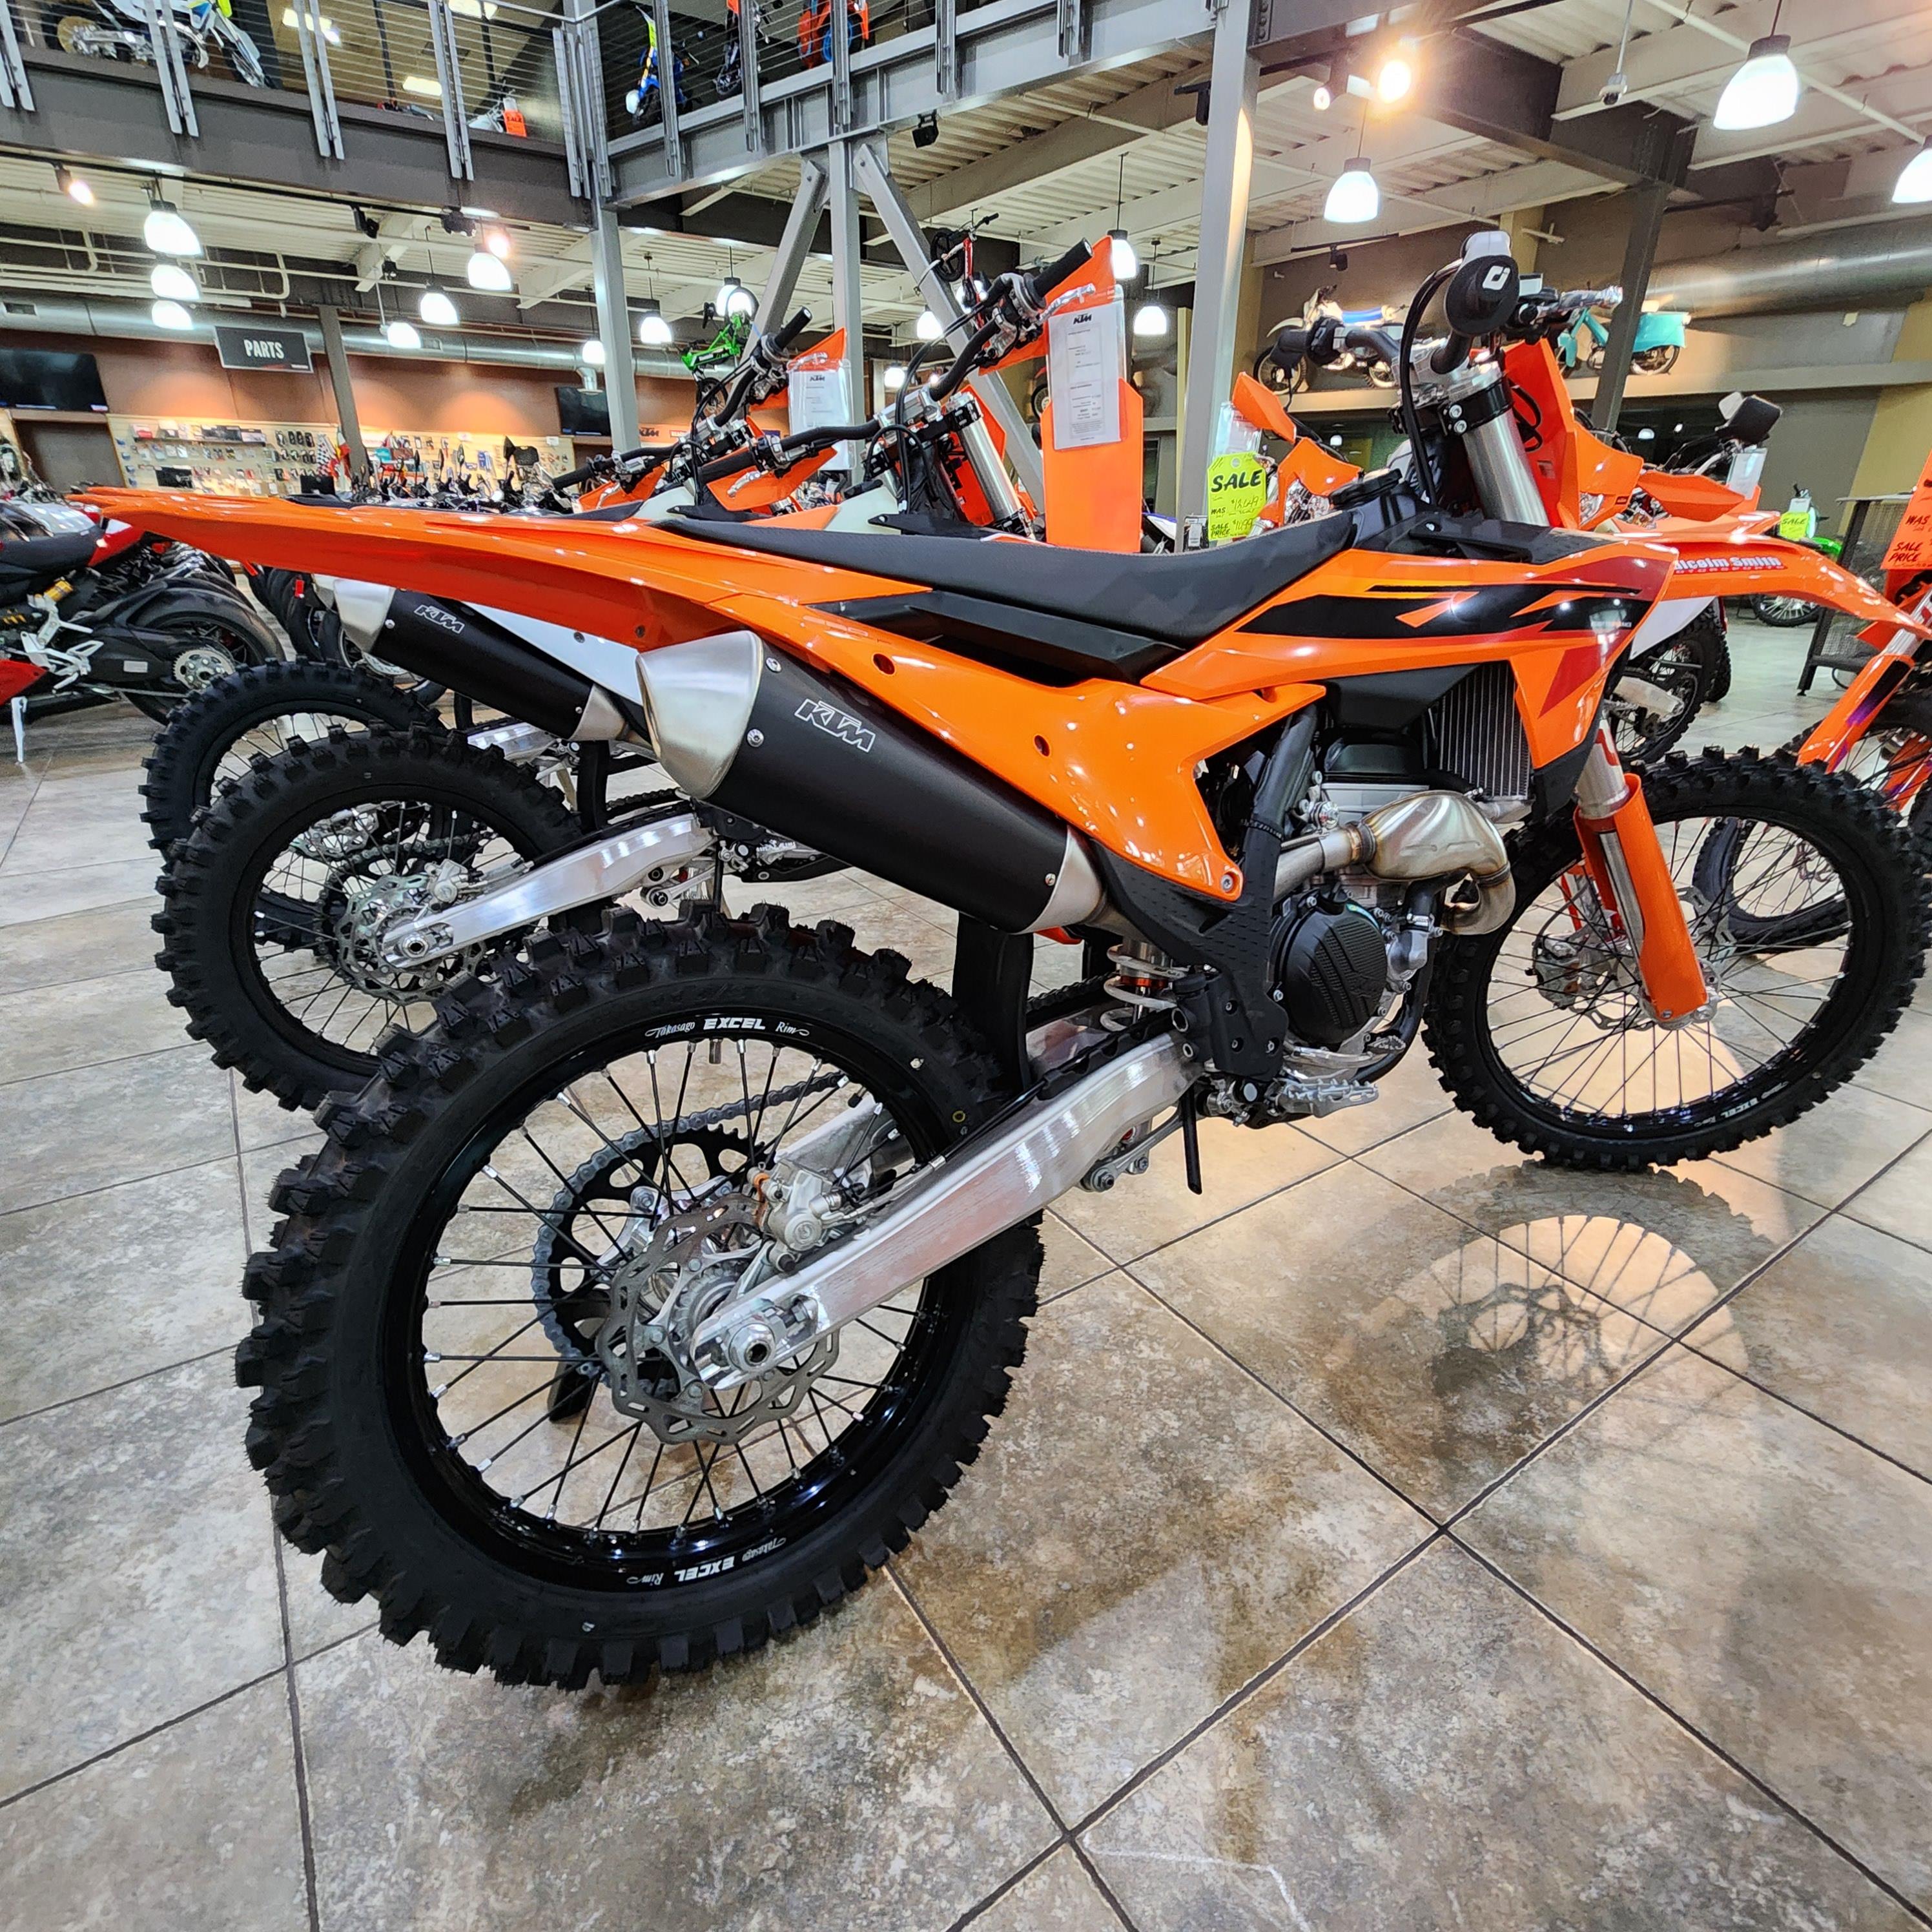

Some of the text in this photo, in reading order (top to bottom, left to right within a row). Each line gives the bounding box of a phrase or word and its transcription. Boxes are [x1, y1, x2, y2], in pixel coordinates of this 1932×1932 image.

[1073, 313, 1092, 325] KTM
[243, 339, 285, 359] PARTS
[1211, 469, 1263, 493] SALE
[1211, 507, 1226, 515] WAS
[1211, 522, 1229, 531] SALE
[1782, 517, 1807, 525] SALE
[1905, 515, 1931, 525] WAS
[1211, 528, 1231, 538] PRICE
[1893, 542, 1924, 551] SALE
[1674, 557, 1729, 570] alcolm
[1729, 556, 1782, 567] Smith
[1888, 552, 1922, 563] PRICE
[414, 604, 465, 634] KTM
[794, 698, 876, 753] KTM
[644, 1017, 810, 1039] Takasago EXCEL Rim
[673, 1556, 735, 1582] EXCEL
[626, 1572, 664, 1586] Rim
